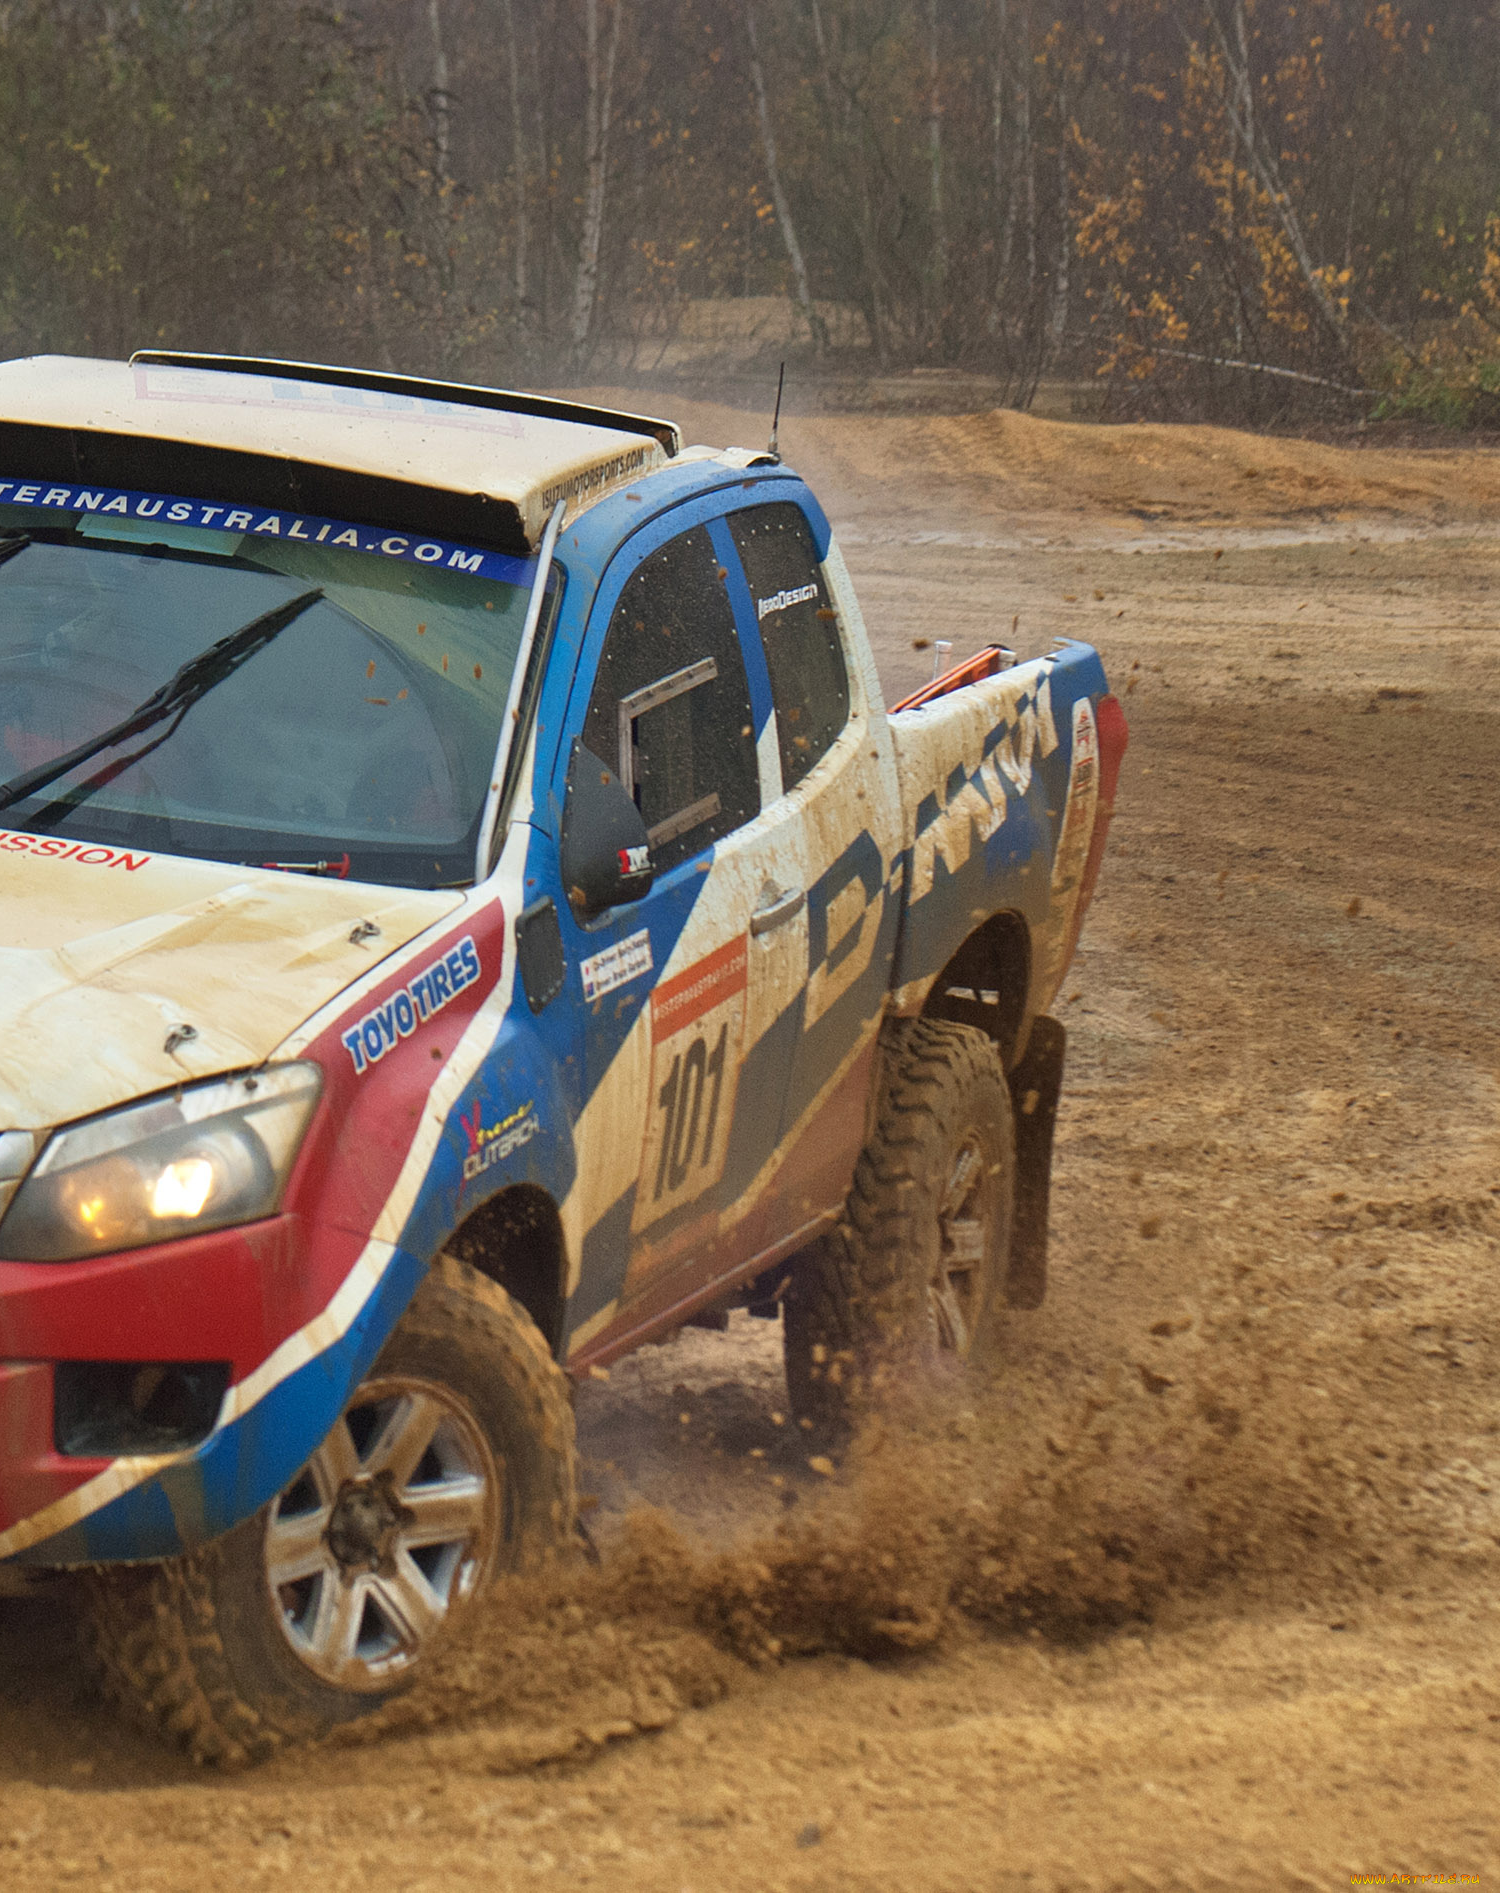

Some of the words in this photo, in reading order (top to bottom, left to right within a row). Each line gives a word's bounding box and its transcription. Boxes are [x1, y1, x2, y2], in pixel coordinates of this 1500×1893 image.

[342, 990, 417, 1074] TOYO
[408, 936, 481, 1021] TIRES
[654, 1021, 728, 1202] 101
